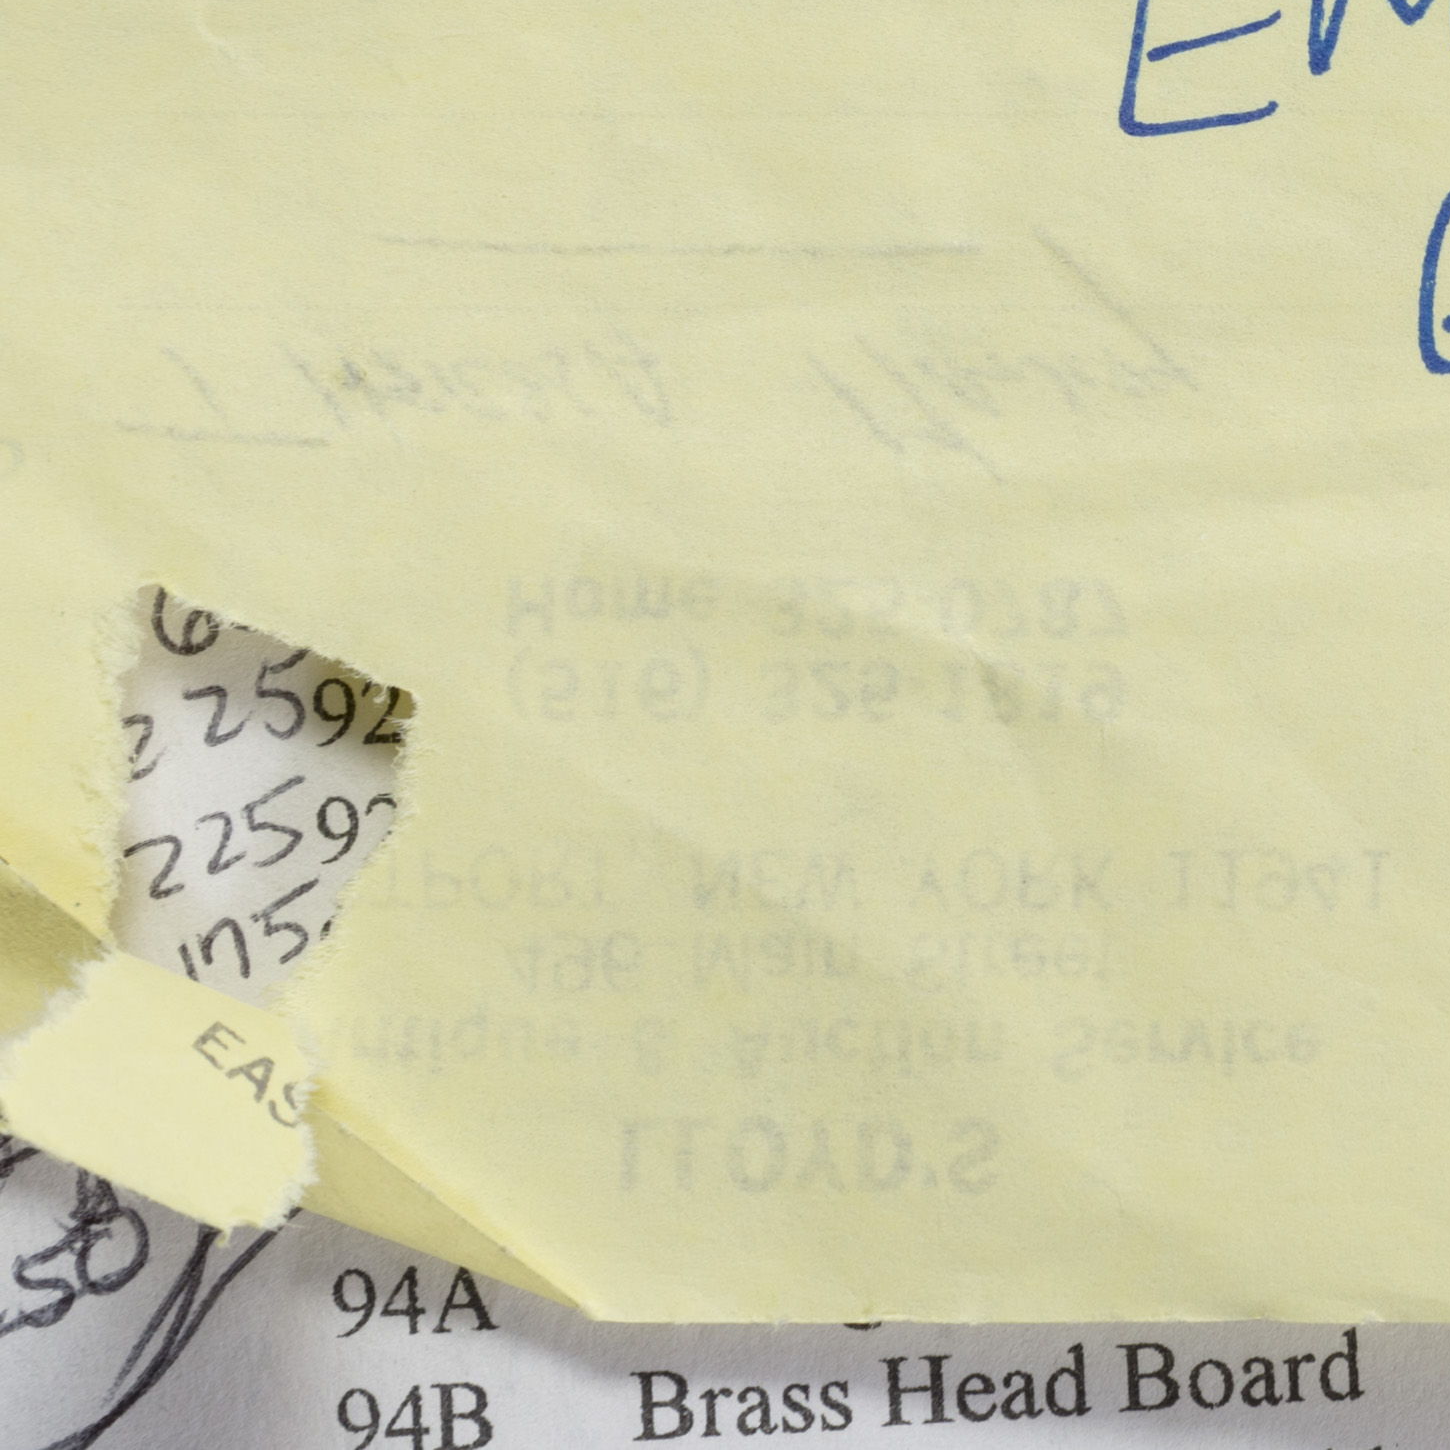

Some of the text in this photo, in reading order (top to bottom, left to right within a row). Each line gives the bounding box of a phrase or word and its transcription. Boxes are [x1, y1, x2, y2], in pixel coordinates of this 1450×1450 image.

[332, 1266, 500, 1337] 94A
[338, 1327, 1365, 1450] 94B Brass Head Board
